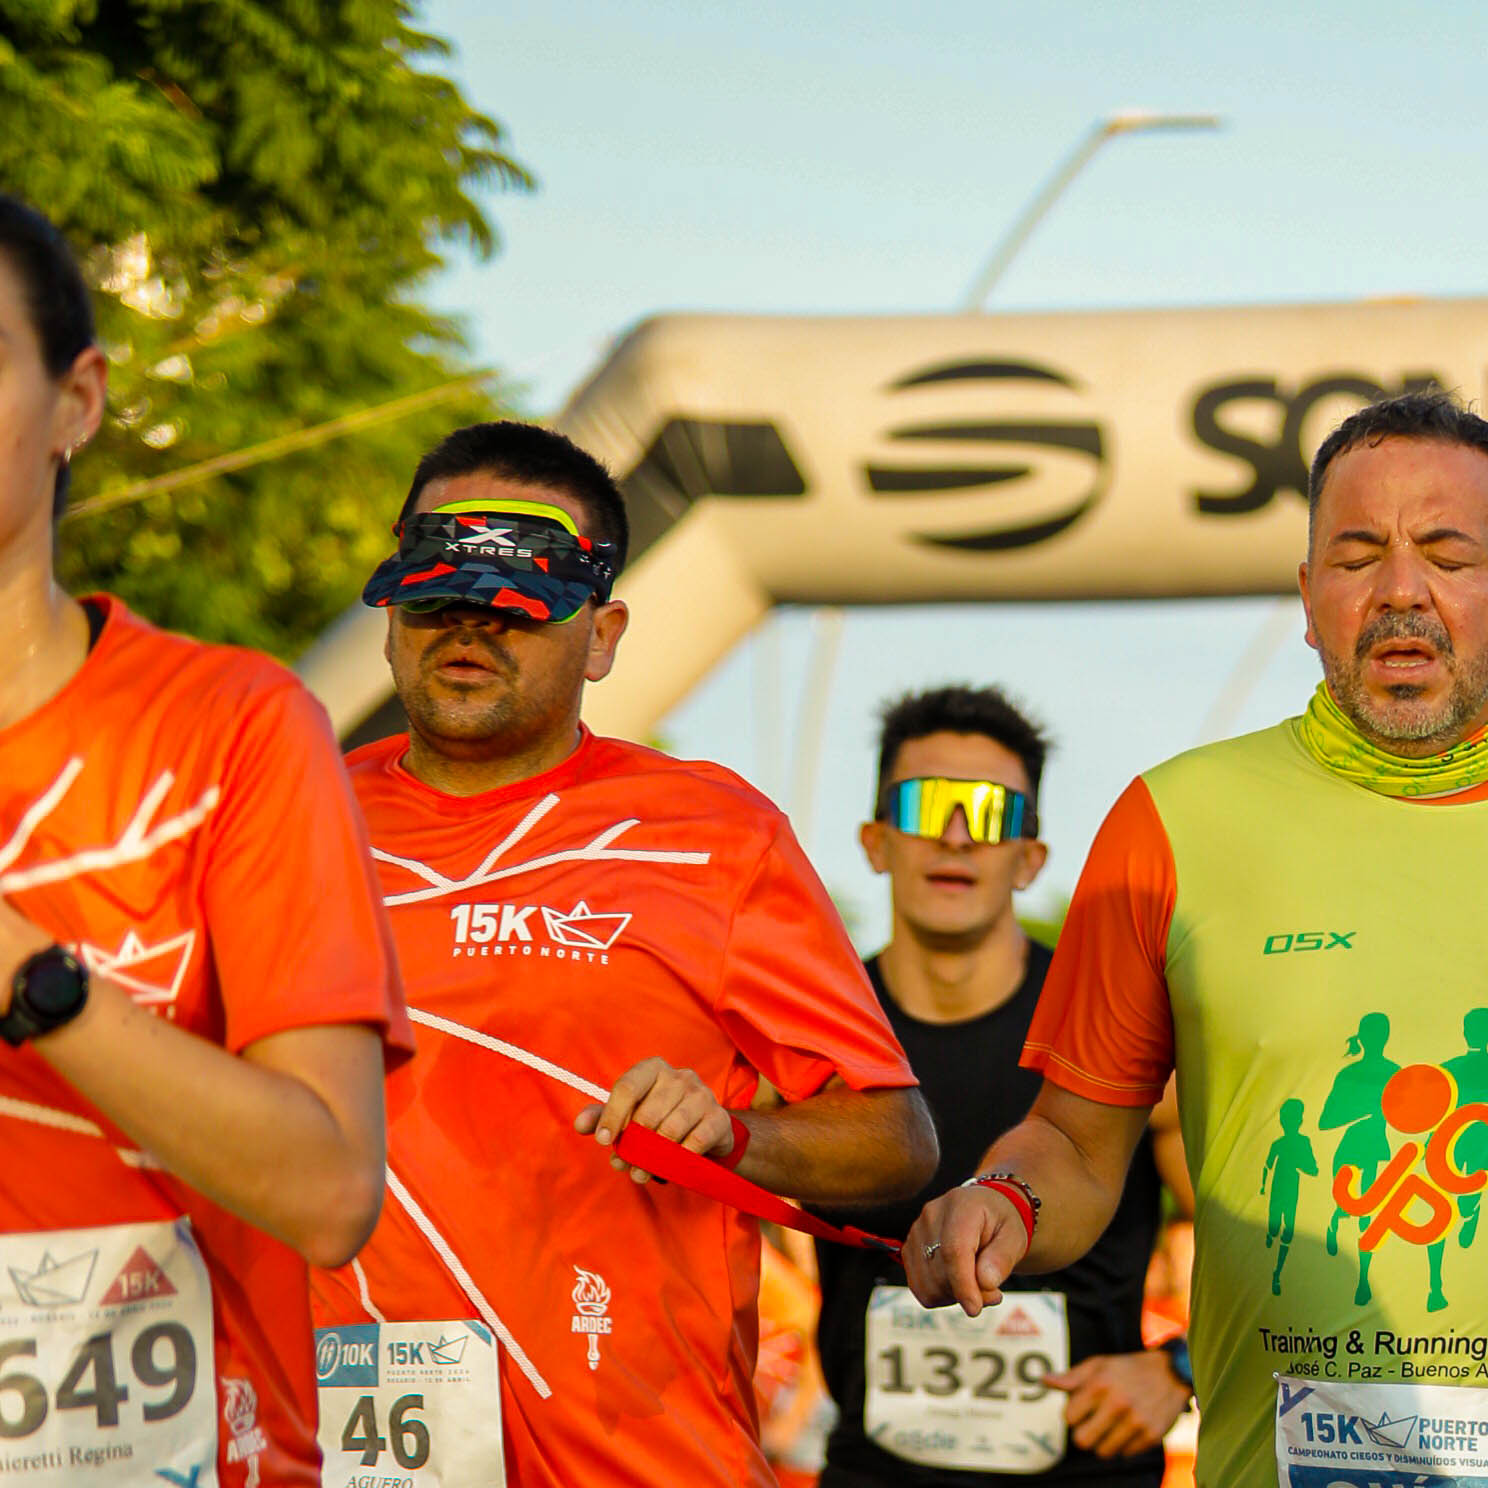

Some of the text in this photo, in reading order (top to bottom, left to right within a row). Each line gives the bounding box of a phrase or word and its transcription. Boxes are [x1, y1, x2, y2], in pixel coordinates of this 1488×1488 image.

[444, 542, 533, 558] XTRES
[450, 904, 538, 943] 15K
[453, 945, 609, 965] PUERTO NORTE
[119, 1270, 160, 1297] 15K
[341, 1343, 376, 1367] 10K
[386, 1342, 425, 1365] 15K
[1259, 1327, 1337, 1359] Training
[1346, 1330, 1364, 1354] &
[1375, 1329, 1488, 1360] Running
[0, 1322, 197, 1440] 649
[878, 1344, 1055, 1402] 1329
[1287, 1360, 1319, 1376] José
[1325, 1361, 1341, 1377] C.
[1348, 1362, 1382, 1378] Paz
[1401, 1362, 1470, 1378] Buenos
[341, 1393, 431, 1470] 46
[1301, 1413, 1363, 1445] 15K
[69, 1443, 134, 1466] Regina
[1288, 1446, 1348, 1460] CAMPEONATO
[1350, 1452, 1385, 1461] CIEGOS
[1386, 1453, 1393, 1462] Y
[1419, 1435, 1478, 1451] NORTE
